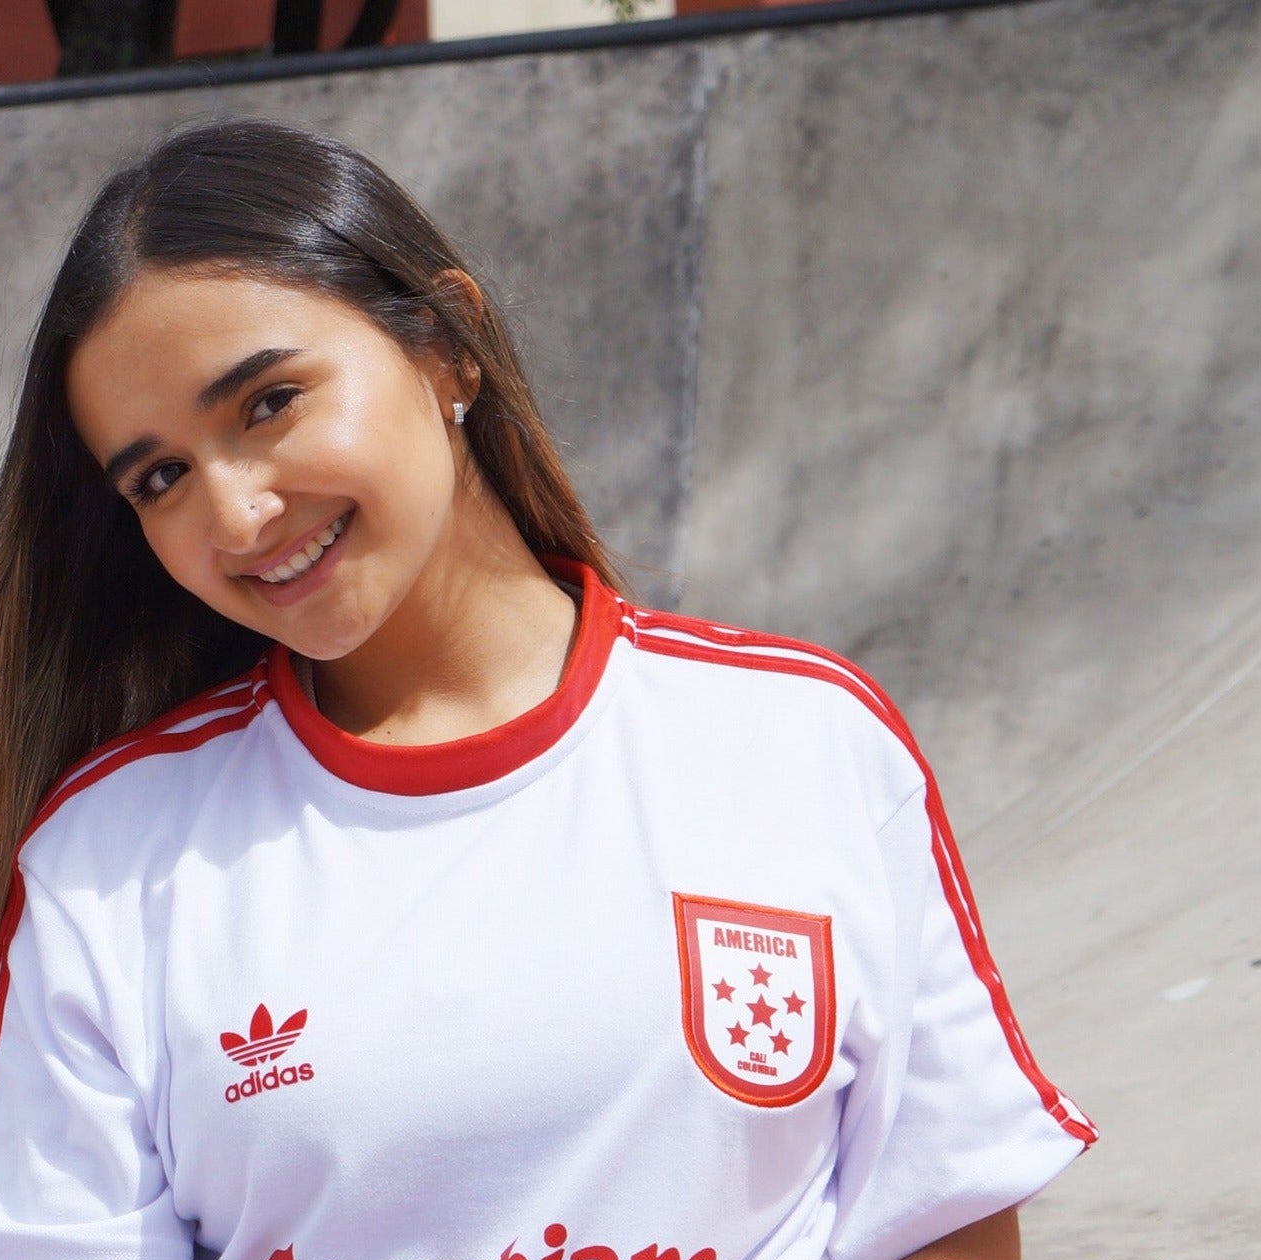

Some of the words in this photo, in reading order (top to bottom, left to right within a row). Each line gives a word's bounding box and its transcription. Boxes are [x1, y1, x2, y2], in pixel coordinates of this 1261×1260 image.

[713, 926, 798, 960] AMERICA
[737, 1060, 778, 1077] COLOMBIA
[749, 1051, 767, 1064] CALI
[225, 1065, 315, 1103] adidas
